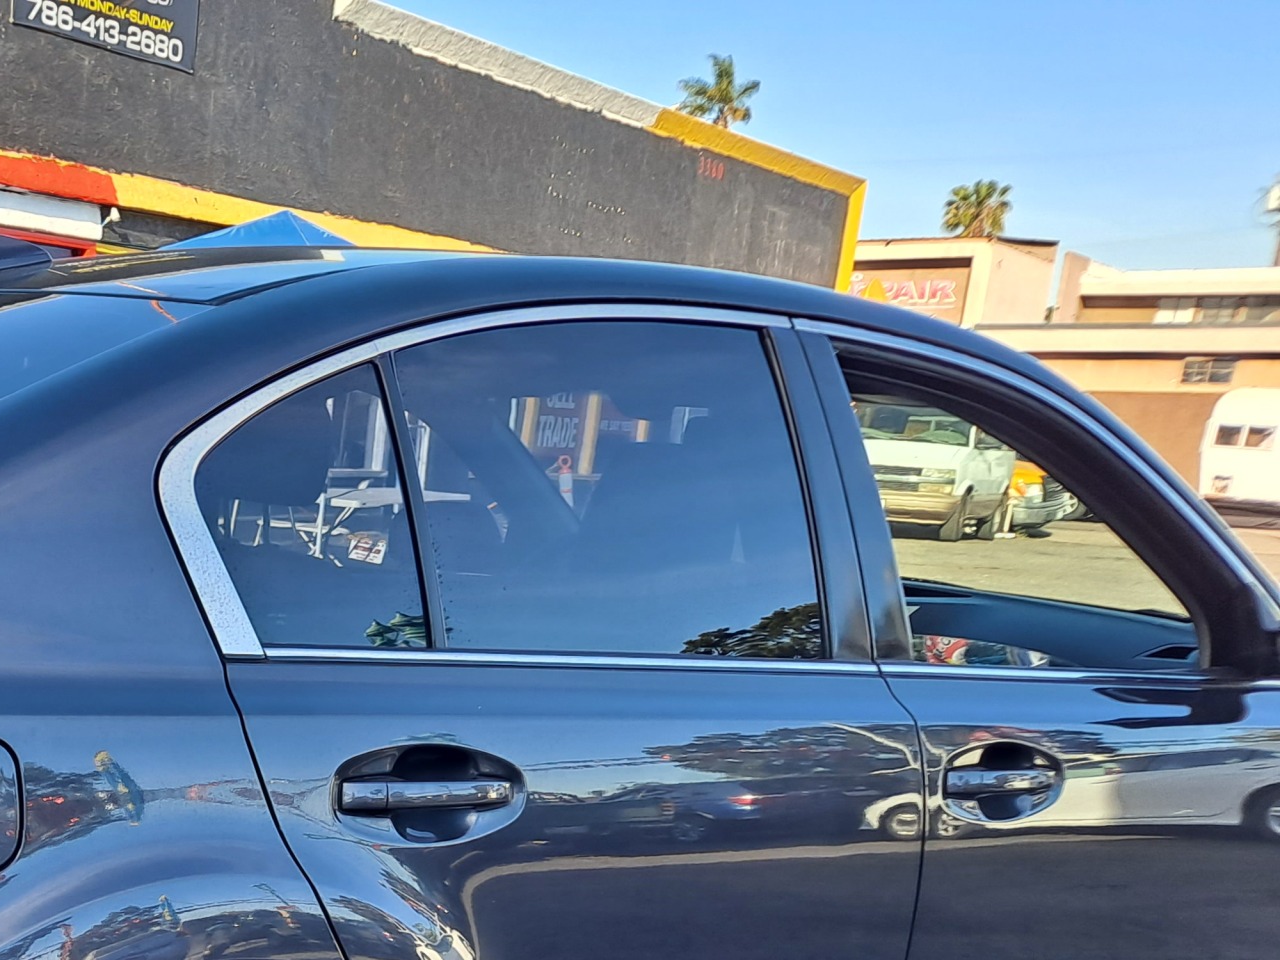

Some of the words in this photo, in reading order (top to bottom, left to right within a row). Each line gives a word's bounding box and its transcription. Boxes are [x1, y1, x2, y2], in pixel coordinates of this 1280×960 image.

[27, 0, 183, 63] 786-413-2680
[76, 0, 174, 33] MONDAY-SUNDAY
[850, 279, 957, 304] PAIR
[536, 415, 579, 449] TRADE
